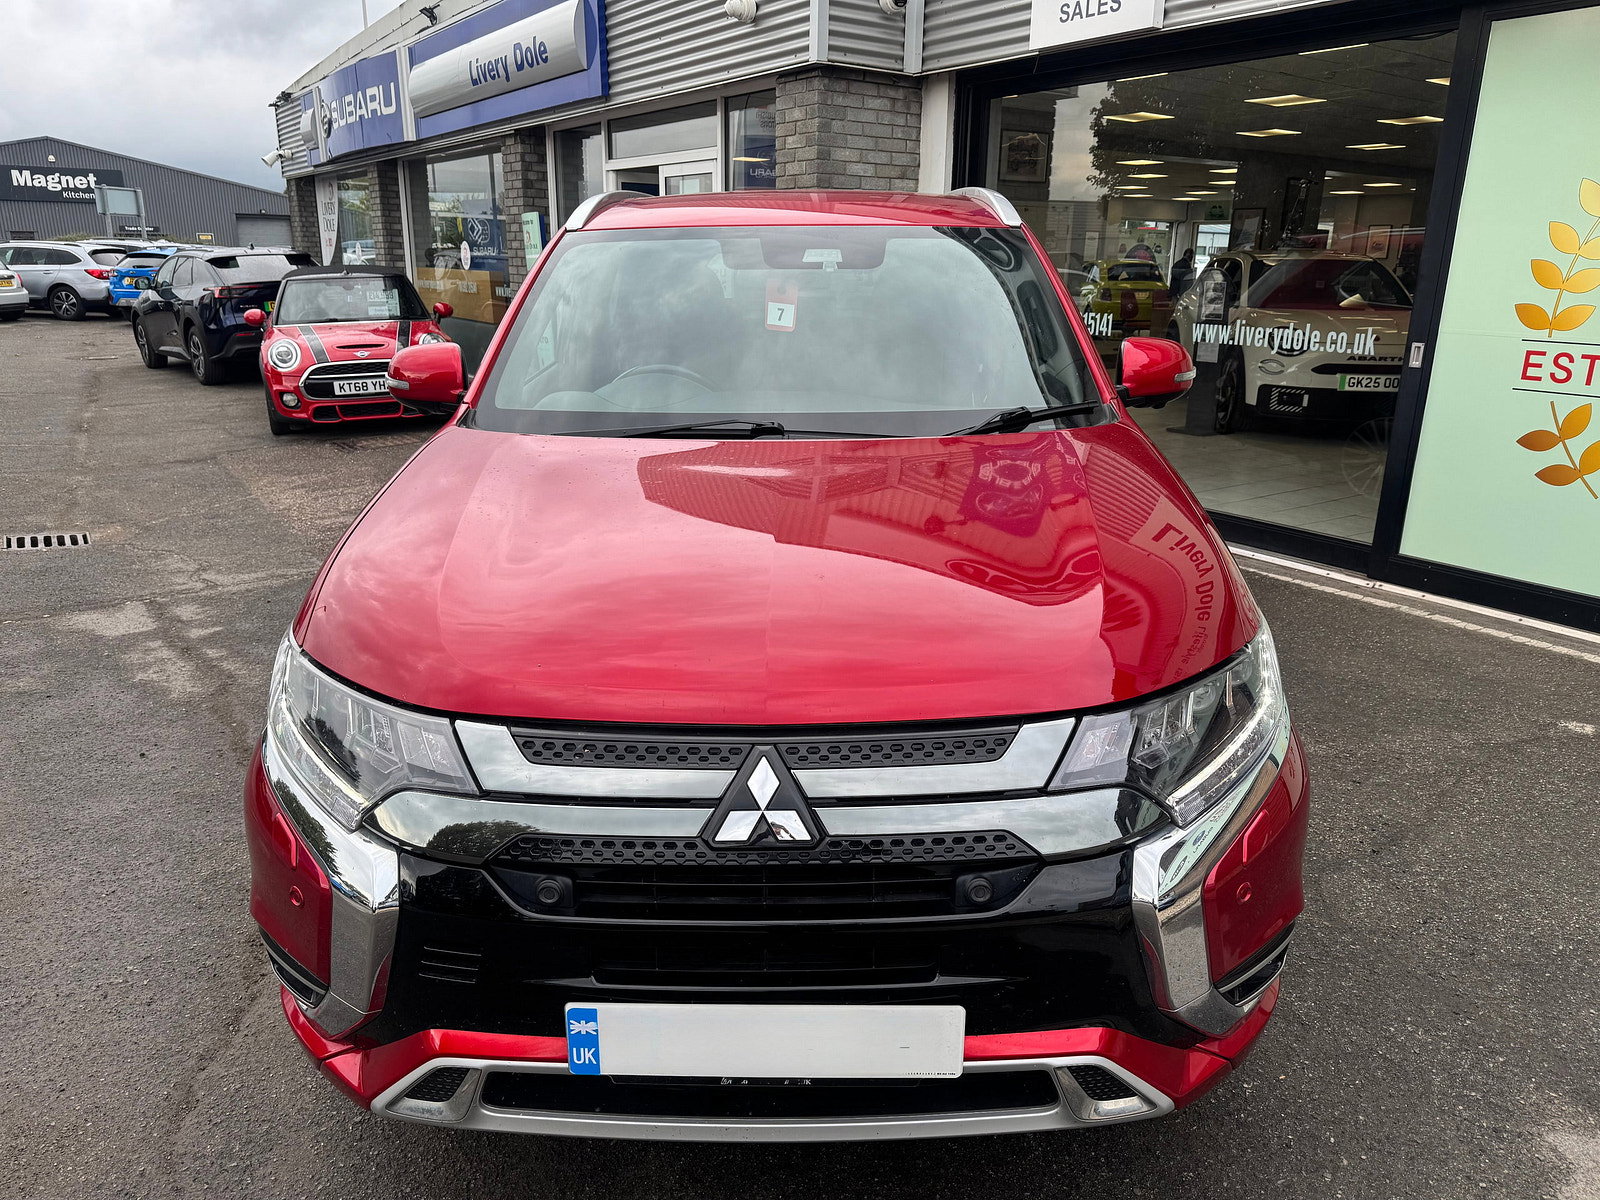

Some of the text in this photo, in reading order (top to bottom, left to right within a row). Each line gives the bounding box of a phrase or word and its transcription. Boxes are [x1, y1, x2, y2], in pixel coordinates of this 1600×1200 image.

[1059, 0, 1122, 23] SALES
[469, 36, 549, 87] Livery Dole
[330, 81, 397, 130] SUBARU
[11, 169, 97, 191] Magnet
[777, 307, 785, 321] 7
[1080, 311, 1113, 336] 15141
[1192, 319, 1378, 355] www.liverydole.co.uk
[338, 380, 389, 393] KT68 YH
[1348, 376, 1382, 388] GK25
[572, 1047, 597, 1064] UK
